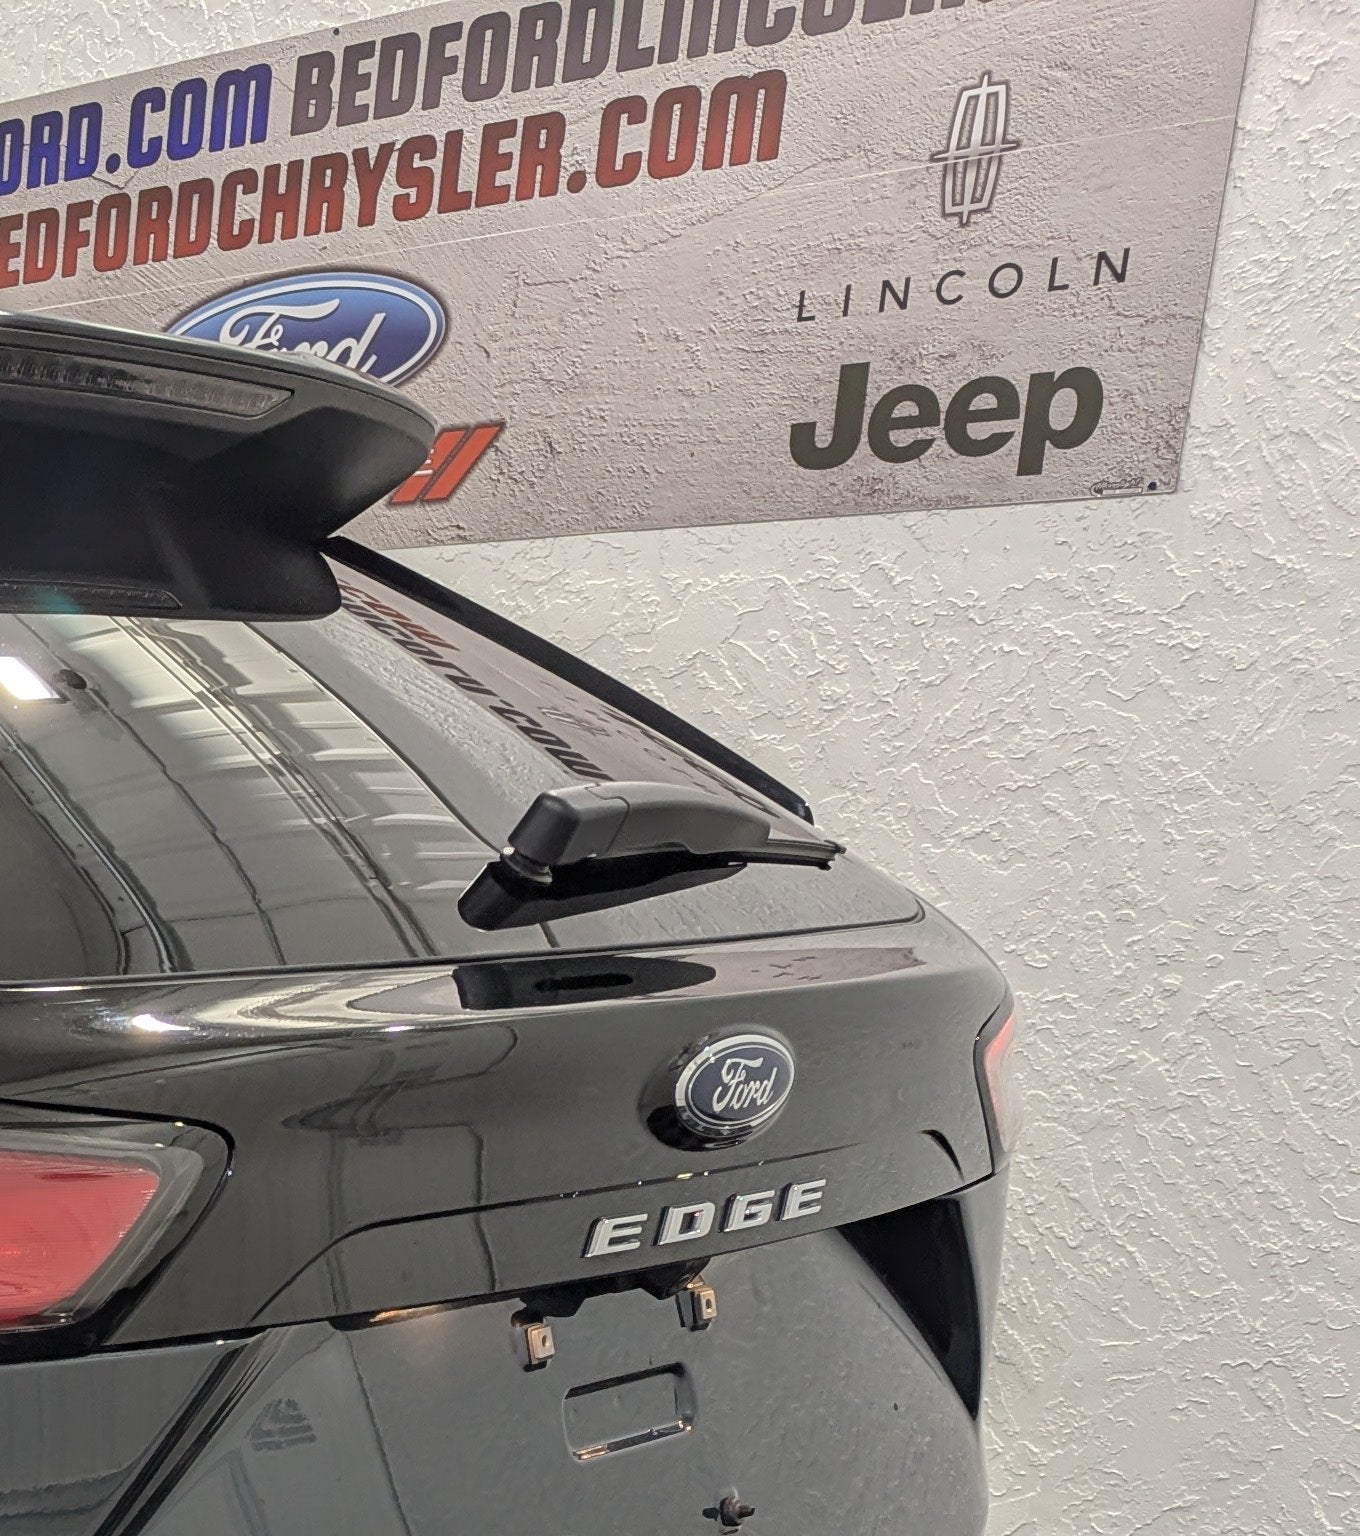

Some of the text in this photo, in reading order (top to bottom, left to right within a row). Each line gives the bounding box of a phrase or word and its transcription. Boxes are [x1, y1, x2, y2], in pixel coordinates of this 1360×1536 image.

[795, 247, 1131, 322] LINCOLN
[788, 361, 1104, 476] Jeep
[712, 1056, 778, 1112] Ford
[581, 1178, 827, 1259] EDGE
